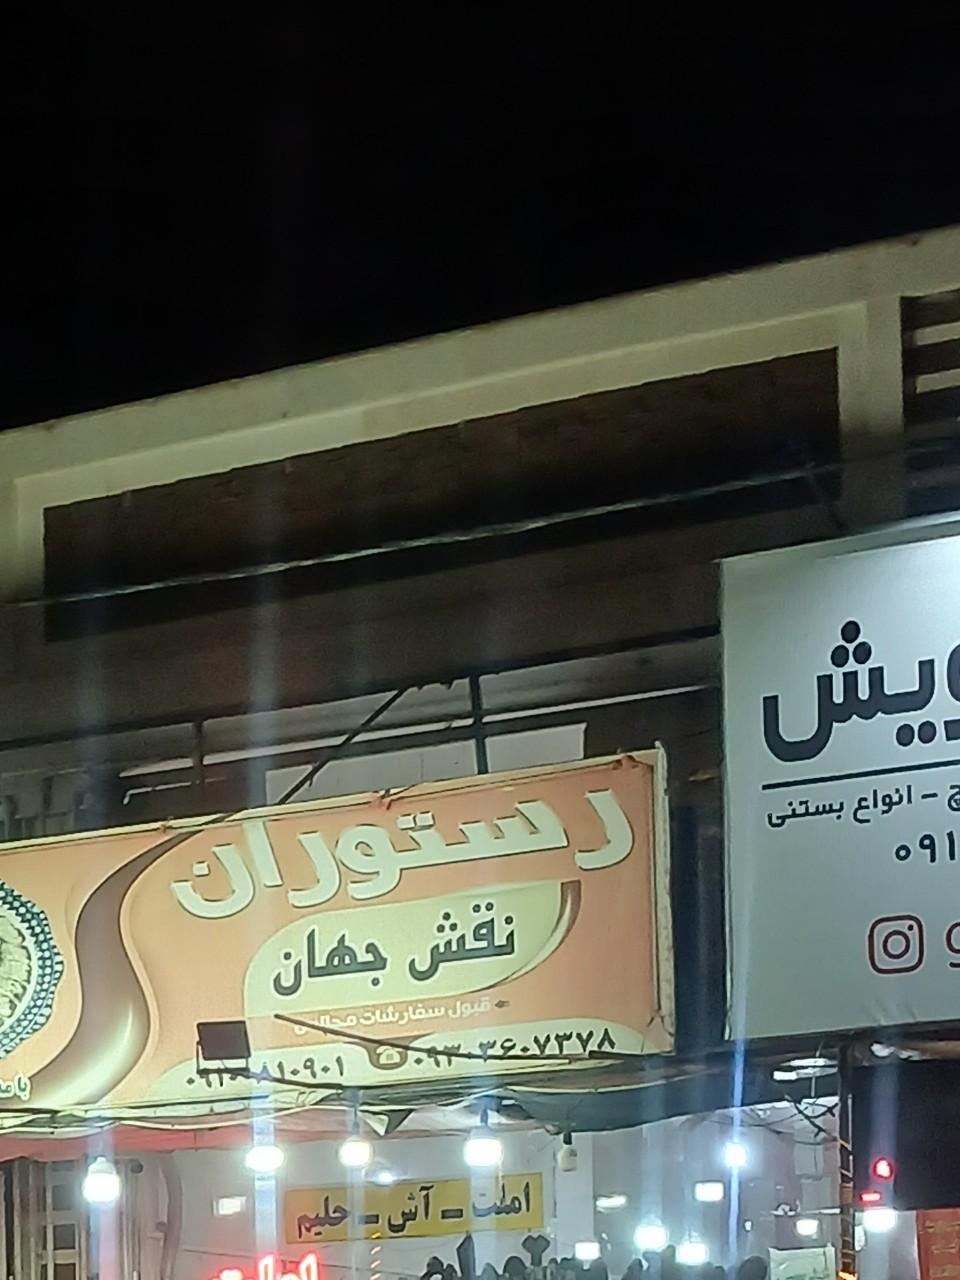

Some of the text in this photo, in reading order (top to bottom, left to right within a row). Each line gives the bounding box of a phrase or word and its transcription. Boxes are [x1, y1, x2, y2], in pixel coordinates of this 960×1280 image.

[767, 799, 844, 829] بستنی
[853, 784, 912, 824] انواع
[170, 788, 635, 919] رستوران
[272, 901, 516, 996] نقش جهان
[359, 1005, 446, 1026] سفارشات
[447, 996, 491, 1019] قبول
[297, 1196, 352, 1239] حلیم
[388, 1185, 435, 1233] آش
[473, 1181, 531, 1218] املت
